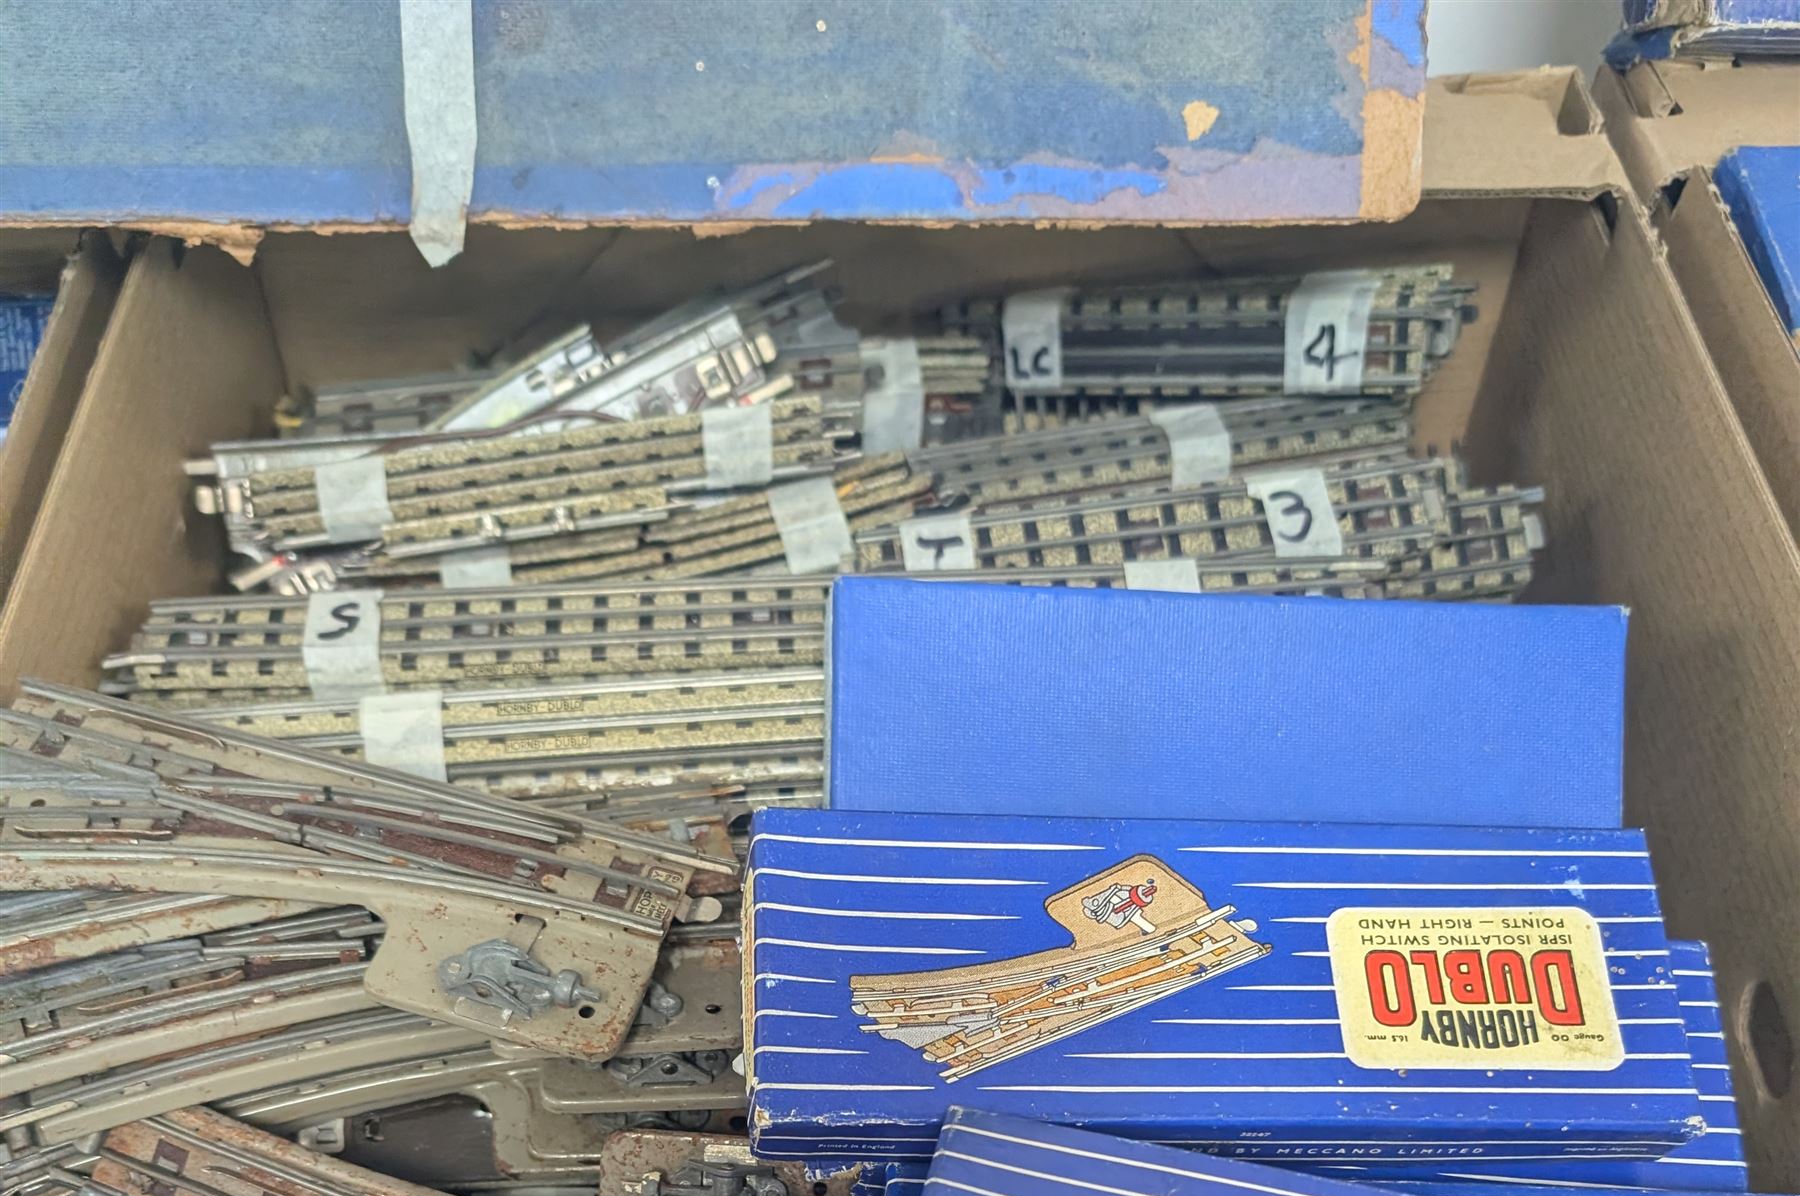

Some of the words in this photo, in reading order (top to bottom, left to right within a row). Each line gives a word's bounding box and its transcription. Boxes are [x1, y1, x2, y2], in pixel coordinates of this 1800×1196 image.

[1302, 323, 1359, 382] 4
[1268, 490, 1312, 543] 3
[1358, 918, 1411, 929] HAND
[1421, 918, 1473, 929] RIGHT
[1501, 917, 1565, 929] POINTS
[1361, 934, 1430, 946] SWITCH
[1437, 934, 1532, 946] ISOLATING
[1539, 934, 1572, 945] ISPR
[1364, 949, 1586, 1027] DUBLO
[1420, 1009, 1540, 1049] HORNBY
[1391, 1034, 1409, 1043] 16.5
[1573, 1034, 1605, 1043] Gauge
[1276, 1147, 1383, 1155] MECCANO
[1397, 1147, 1484, 1155] LIMITED
